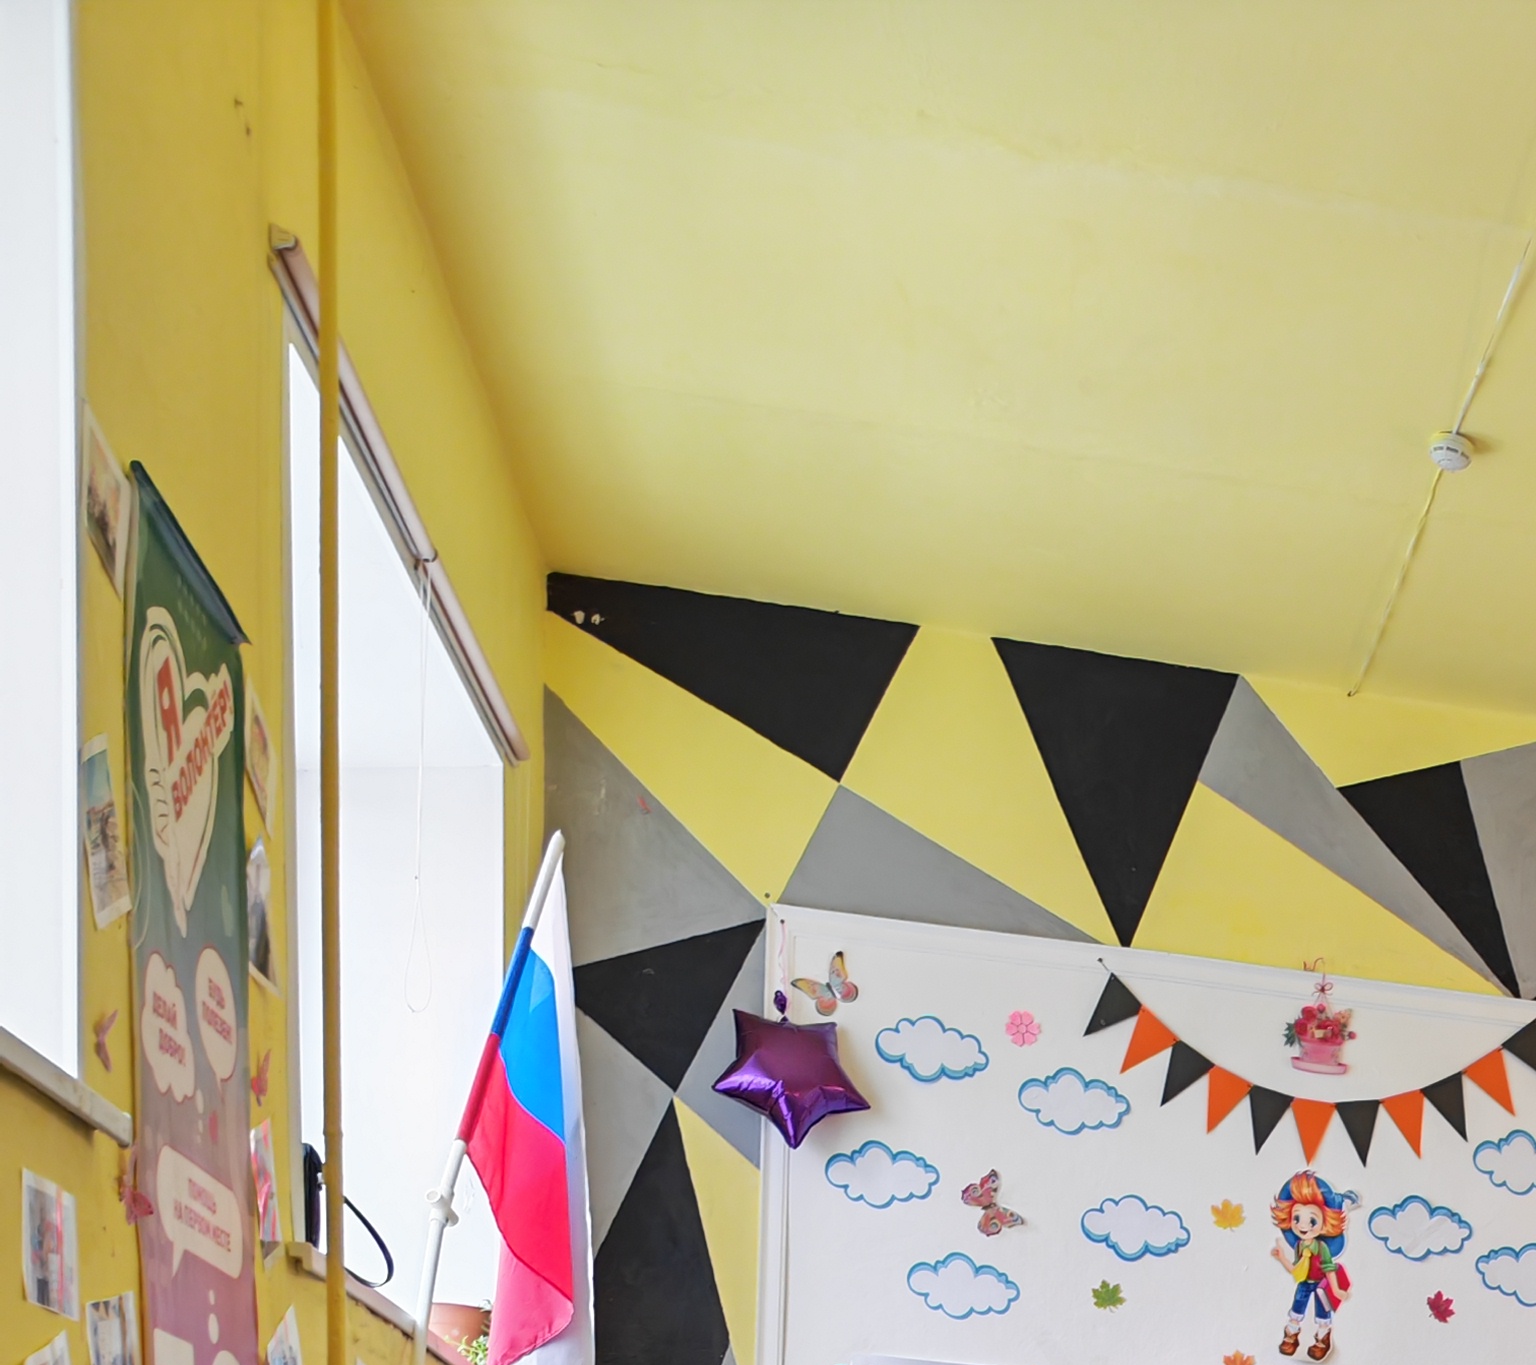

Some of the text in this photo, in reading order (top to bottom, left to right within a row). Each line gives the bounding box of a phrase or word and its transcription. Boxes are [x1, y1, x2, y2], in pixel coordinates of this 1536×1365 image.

[157, 656, 182, 767] Я
[173, 1198, 183, 1221] НА
[212, 1226, 232, 1252] МЕСТЕ
